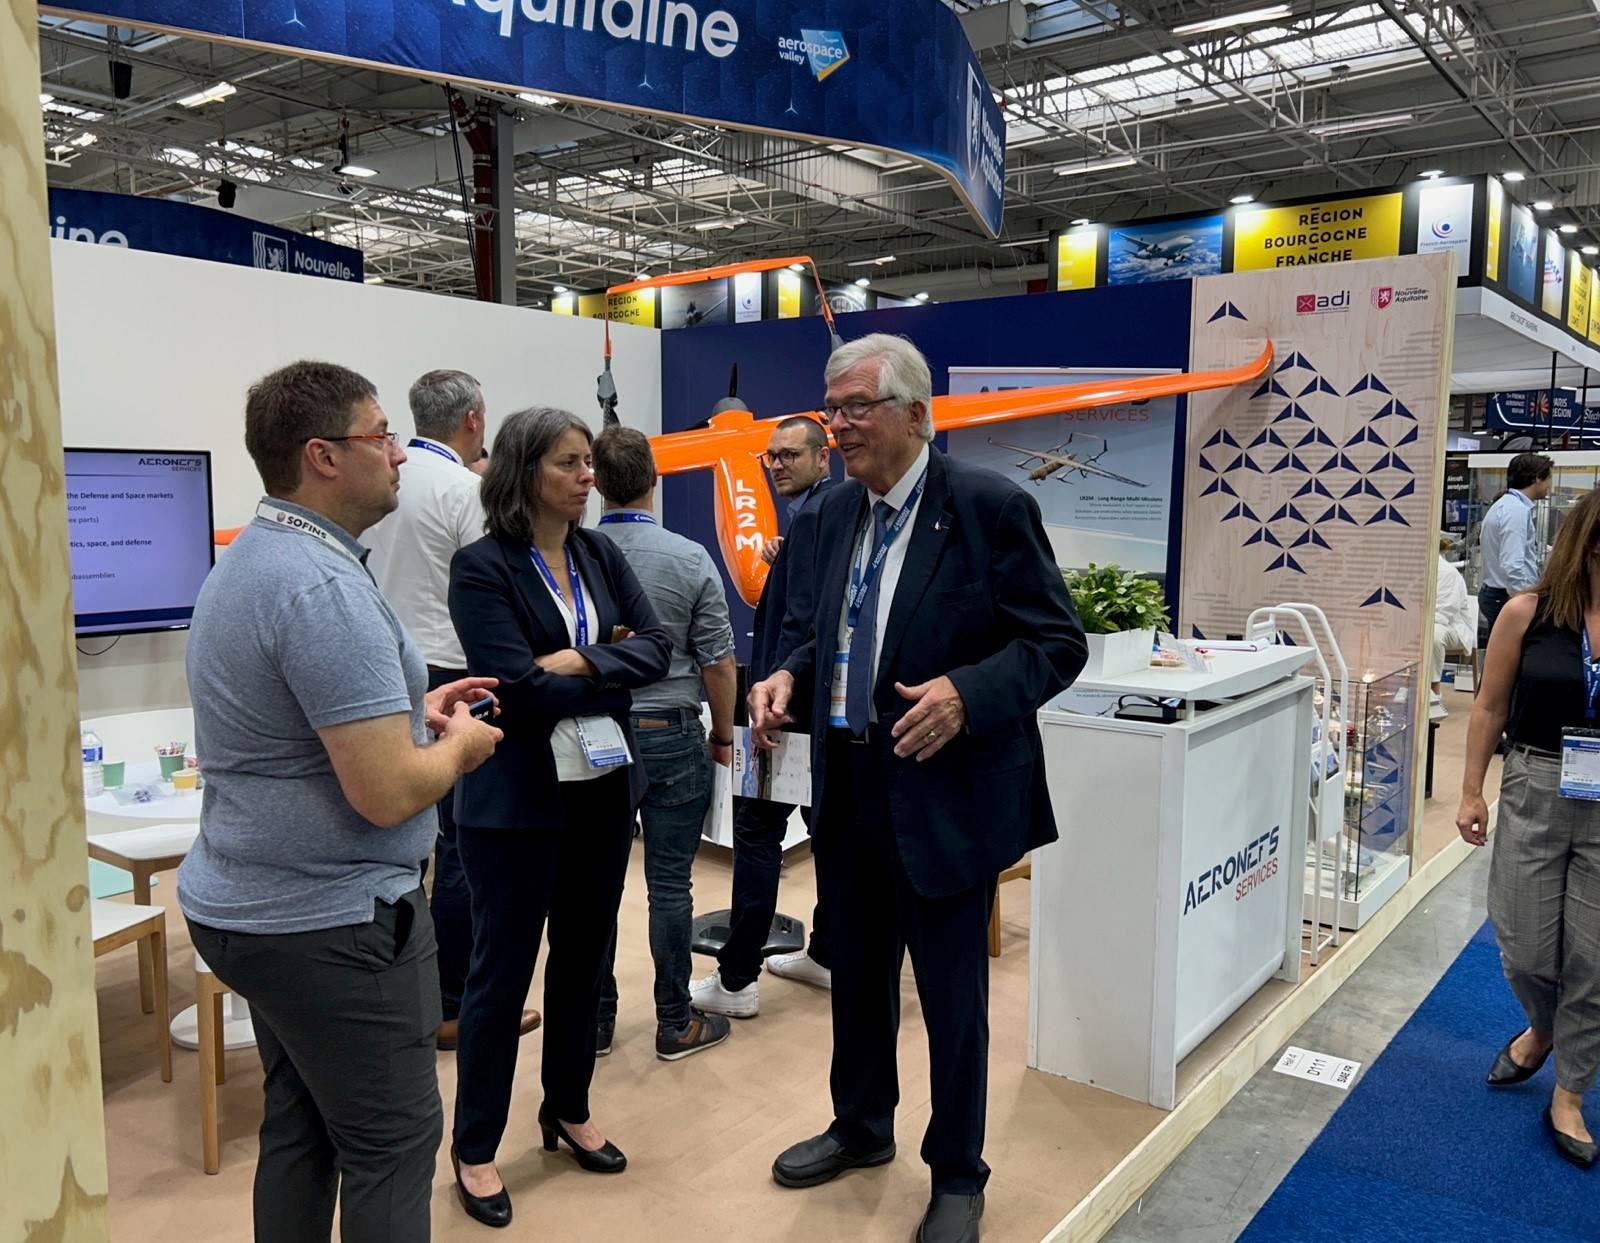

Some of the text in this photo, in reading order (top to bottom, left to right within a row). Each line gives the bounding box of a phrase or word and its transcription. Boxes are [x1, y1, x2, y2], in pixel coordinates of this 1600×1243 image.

[452, 0, 739, 58] quaine
[778, 37, 843, 60] aerospace
[779, 51, 805, 65] valley
[50, 216, 129, 249] ine
[1264, 227, 1368, 249] BOURGOGNE
[294, 251, 355, 280] Nouvelle-
[1275, 249, 1353, 268] FRANCHE
[1317, 290, 1350, 308] adi
[1395, 294, 1429, 303] Aquitaine
[1553, 397, 1568, 407] ARIS
[1064, 408, 1150, 422] SERVICES
[138, 458, 203, 467] AERONEFS
[80, 492, 109, 500] Defense
[110, 492, 125, 500] and
[125, 492, 146, 501] Space
[78, 516, 100, 525] parts)
[286, 514, 328, 540] SOFINS
[86, 540, 110, 549] space,
[1183, 824, 1280, 916] AERONEFS
[1235, 857, 1279, 902] SERVICES
